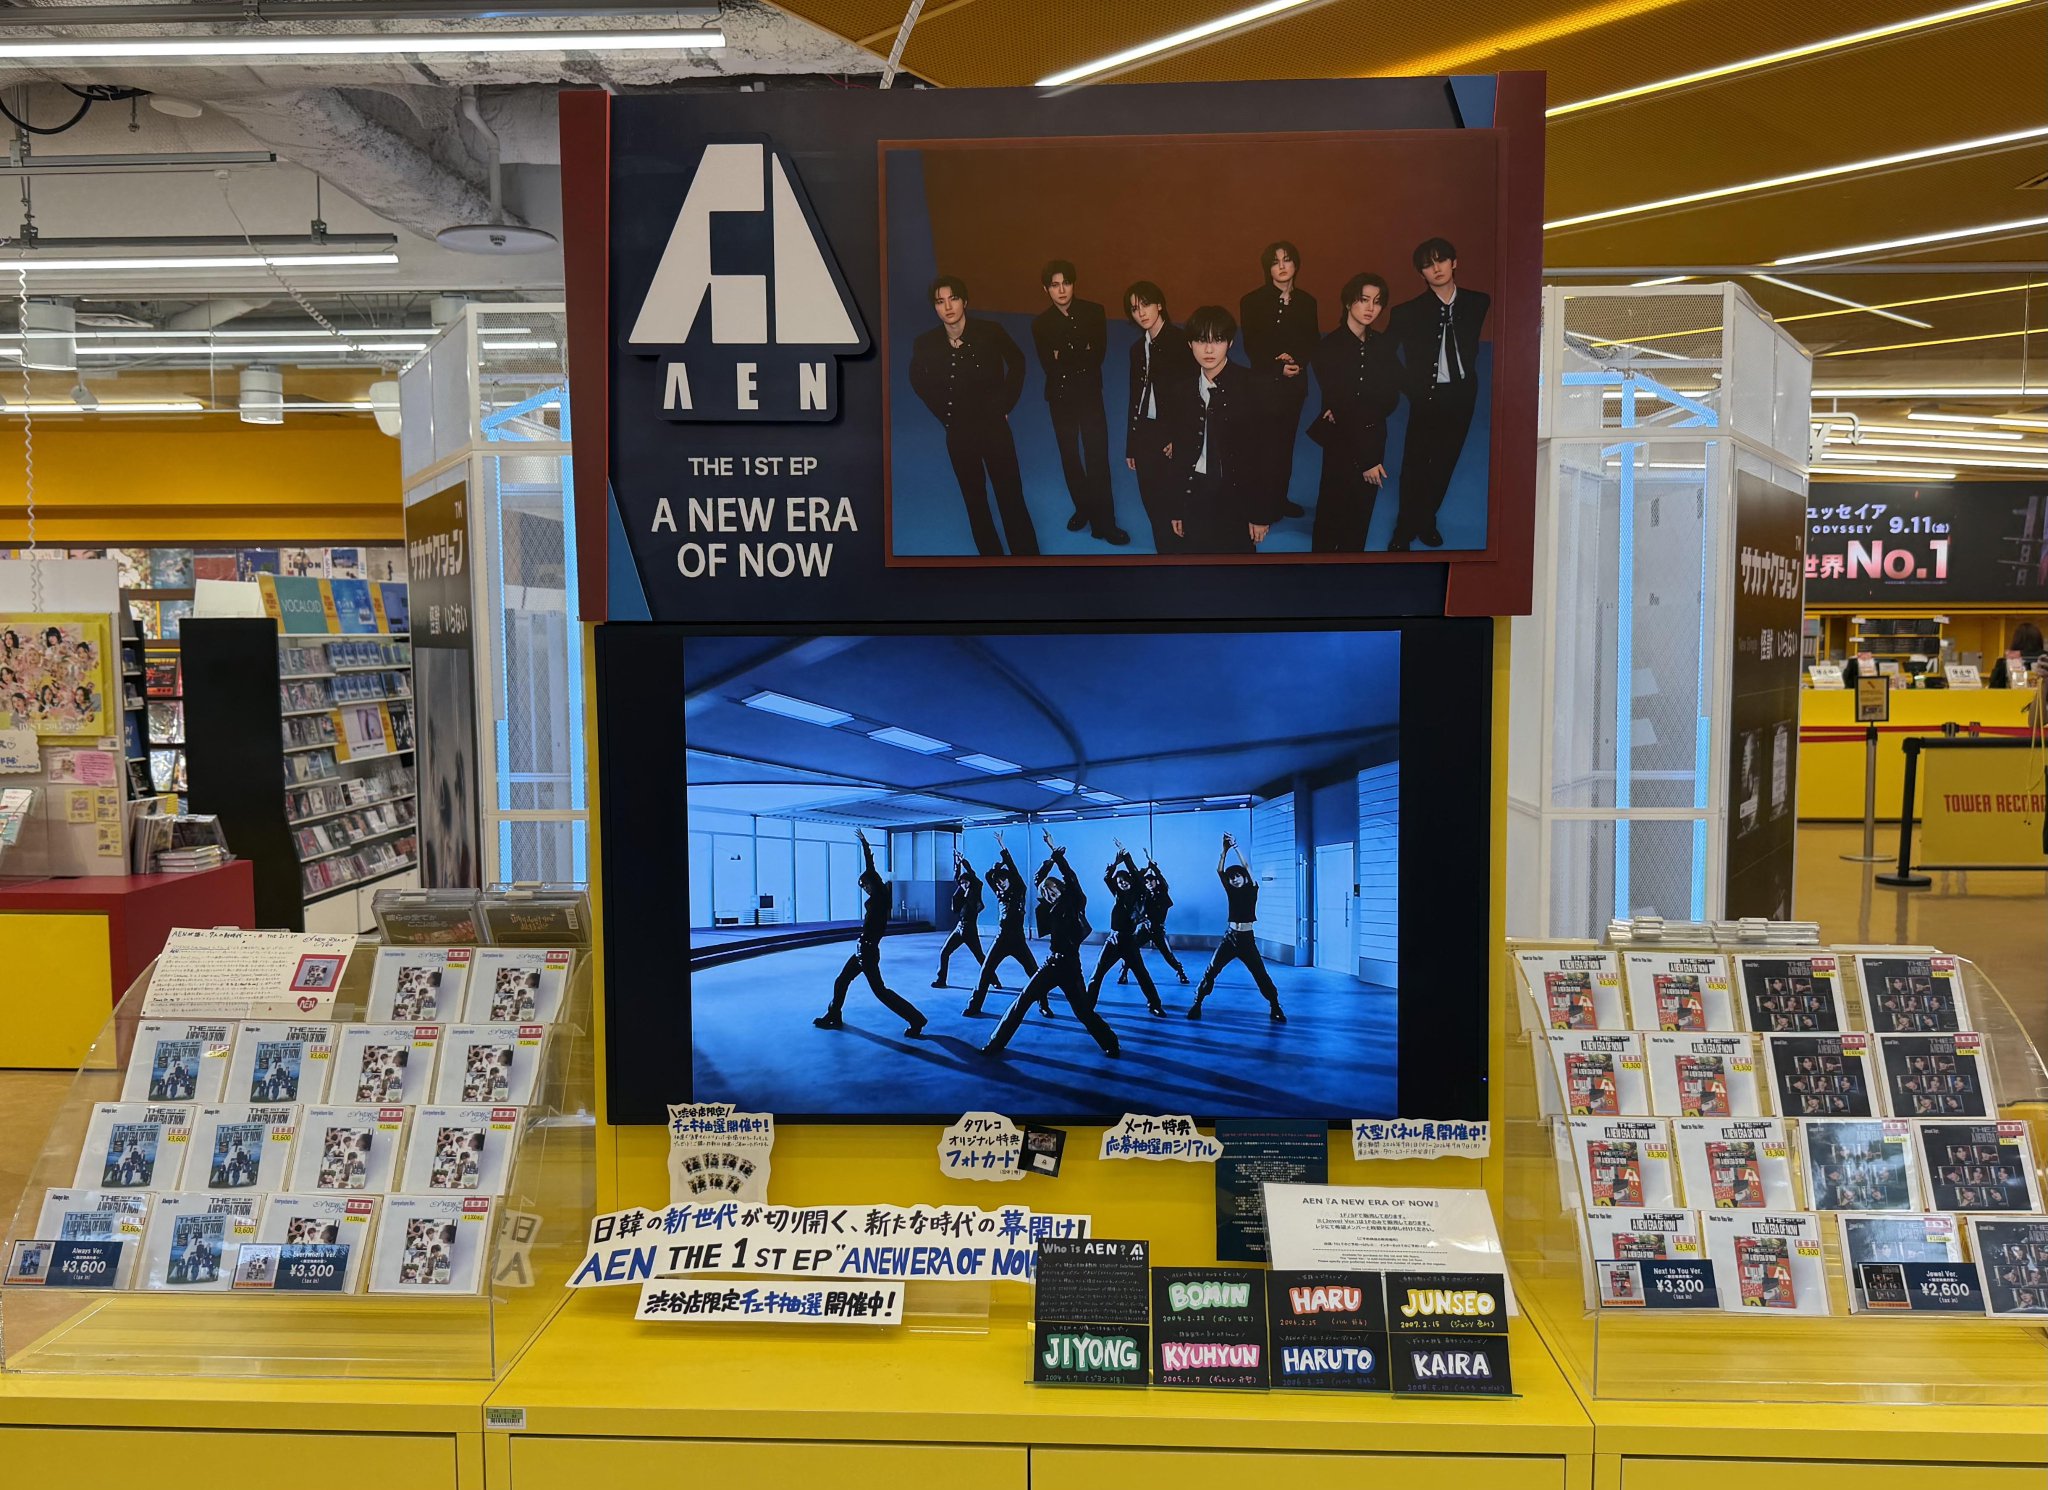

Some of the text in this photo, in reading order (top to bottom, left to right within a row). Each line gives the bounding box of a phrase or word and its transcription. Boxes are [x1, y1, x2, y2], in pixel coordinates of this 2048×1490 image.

[688, 457, 818, 476] THE 1ST EP
[651, 497, 859, 533] A NEW ERA
[1812, 525, 1873, 534] ODYSSEY
[410, 529, 463, 581] サカナクション
[677, 542, 834, 578] OF NOW
[1740, 546, 1801, 600] サカナクション
[281, 599, 323, 613] VOCALOID
[1777, 628, 1798, 658] いらない
[1944, 794, 1992, 813] TOWER
[677, 1106, 726, 1119] 渋谷店限定
[964, 1119, 1002, 1133] タワレコ
[1125, 1118, 1191, 1136] メーカー特典
[1355, 1122, 1487, 1141] 大型パネル展開催中!
[271, 1134, 292, 1142] ¥3,600
[948, 1133, 1021, 1147] オリジナル特典
[1106, 1134, 1218, 1157] 応募抽選用シリアル
[946, 1149, 1020, 1168] フォトカード
[1302, 1197, 1323, 1205] AEN
[1341, 1198, 1365, 1206] NEW
[1368, 1198, 1390, 1207] ERA
[1391, 1199, 1406, 1207] OF
[234, 1226, 254, 1234] ¥3,600
[72, 1247, 104, 1255] Always Ver.
[1042, 1243, 1067, 1254] Who
[1070, 1244, 1081, 1253] is
[1084, 1242, 1117, 1255] AEN
[1797, 1248, 1819, 1256] ¥3,300
[62, 1260, 107, 1274] ¥3,600
[289, 1264, 335, 1278] ¥3,300
[573, 1245, 657, 1285] AEN
[669, 1243, 722, 1270] THE
[792, 1248, 832, 1271] EP
[1653, 1267, 1669, 1275] Next
[1926, 1270, 1959, 1278] Jewel Ver.
[1656, 1279, 1705, 1294] ¥3,300
[1920, 1282, 1970, 1297] ¥2,600
[1170, 1283, 1249, 1309] BOMIN
[1291, 1288, 1360, 1313] HARU
[1401, 1290, 1494, 1316] JUNSEO
[1044, 1335, 1138, 1369] JIYONG
[1163, 1344, 1258, 1369] KYUHYUN
[1282, 1347, 1374, 1373] HARUTO
[1412, 1352, 1491, 1378] KAIRA
